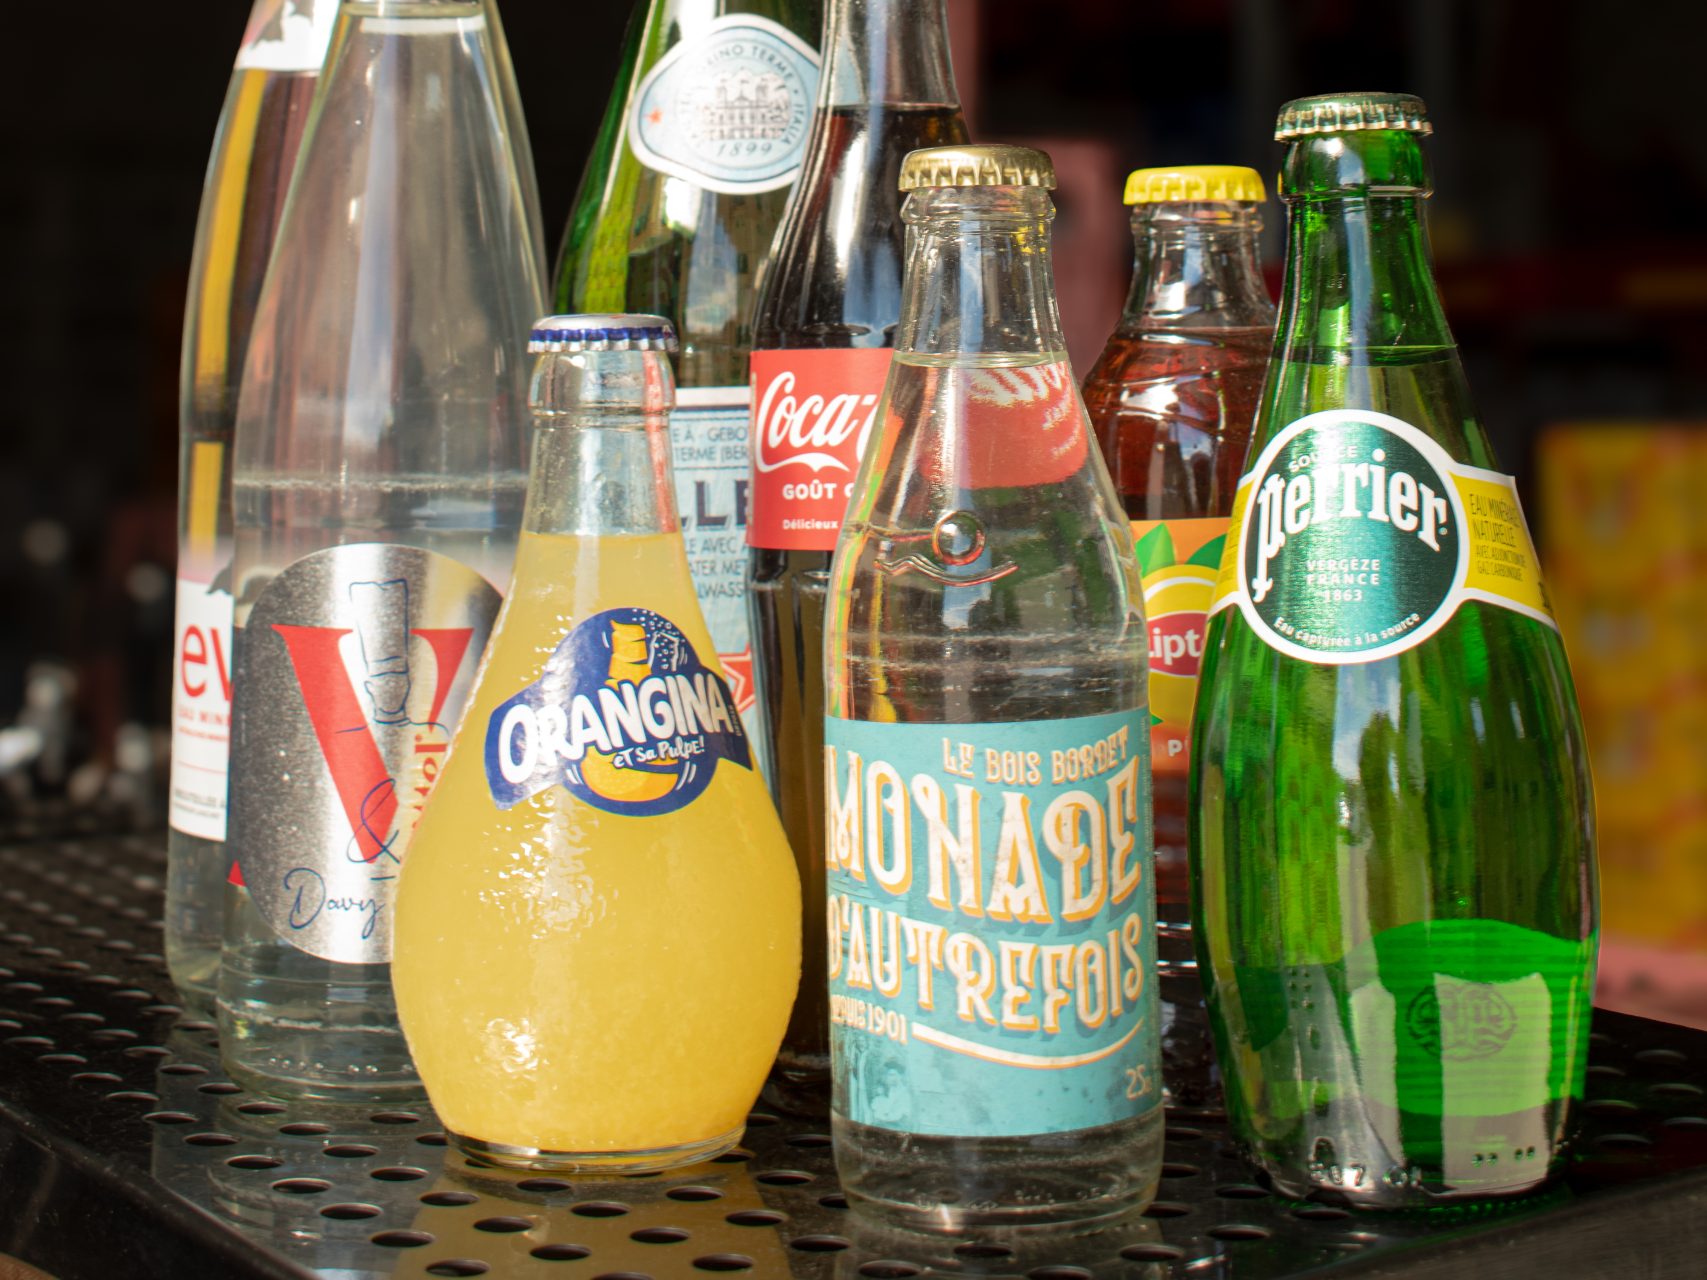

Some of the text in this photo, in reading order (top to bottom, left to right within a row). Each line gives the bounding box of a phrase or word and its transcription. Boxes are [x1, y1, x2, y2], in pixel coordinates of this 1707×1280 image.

[751, 45, 794, 80] TERME
[717, 142, 773, 157] 1899
[1288, 445, 1359, 473] SOUCE
[783, 479, 838, 500] GOÛT
[783, 519, 839, 531] Délicieux
[1306, 557, 1381, 572] VERGÈZE
[1306, 573, 1381, 586] FRANCE
[1323, 588, 1364, 603] 1863
[1273, 616, 1295, 636] Eau
[1365, 631, 1379, 644] la
[1381, 612, 1421, 639] source
[1148, 626, 1201, 666] ipt
[499, 673, 735, 784] ORANGINA
[942, 724, 1130, 786] LE BOIS BORDET
[284, 867, 386, 940] Davy
[867, 1002, 908, 1046] 1901
